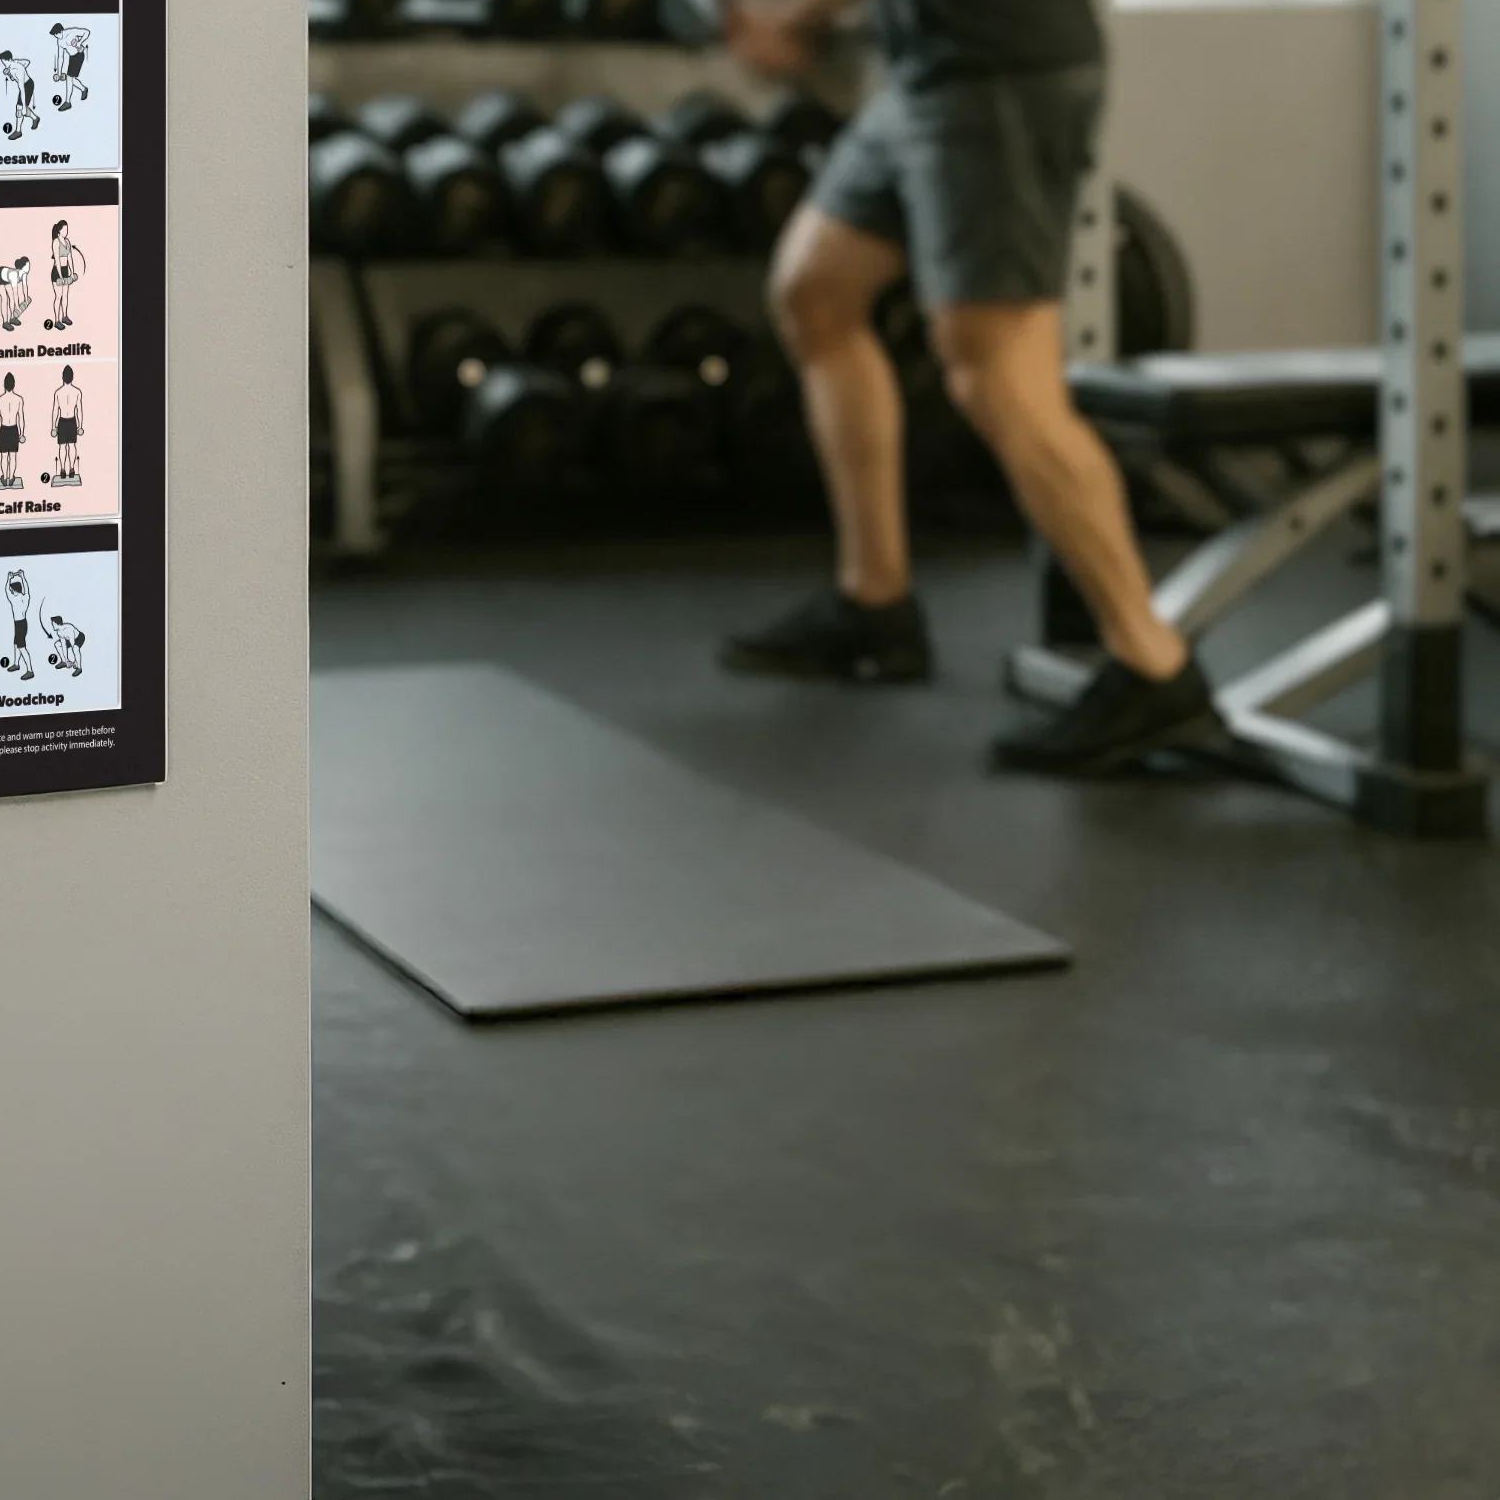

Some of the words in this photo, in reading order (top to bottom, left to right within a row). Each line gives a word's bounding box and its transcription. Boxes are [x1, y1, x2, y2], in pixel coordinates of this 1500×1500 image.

[41, 152, 70, 164] Row
[37, 343, 91, 357] Deadlift
[25, 499, 61, 513] Raise
[7, 732, 21, 742] and
[22, 732, 43, 740] warm
[44, 731, 55, 740] up
[56, 730, 64, 738] or
[65, 727, 90, 737] stretch
[91, 725, 115, 735] before
[23, 744, 40, 754] stop
[41, 742, 68, 752] activity
[69, 738, 115, 749] immediately.
